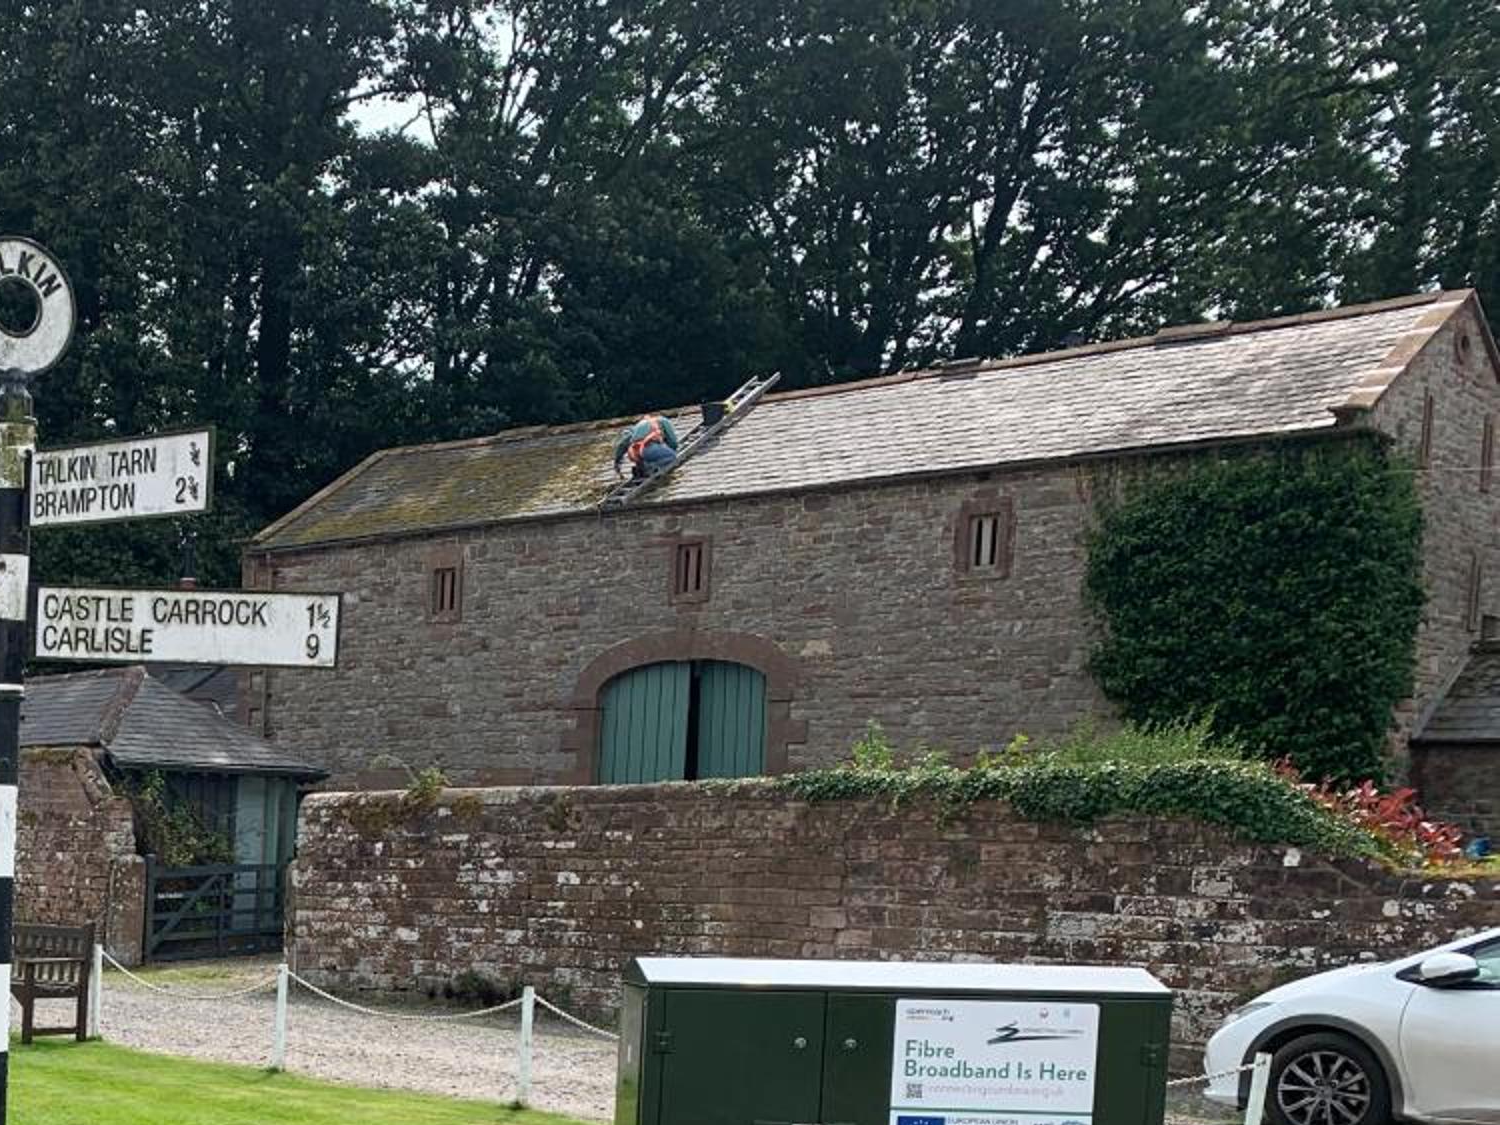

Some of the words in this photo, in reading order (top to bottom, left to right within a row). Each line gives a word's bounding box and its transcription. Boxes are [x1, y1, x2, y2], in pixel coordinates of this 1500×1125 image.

[36, 454, 97, 485] TALKIN
[108, 447, 157, 478] TARN
[34, 482, 135, 519] BRAMPTON
[43, 593, 133, 623] CASTLE
[152, 599, 268, 628] CARROCK
[42, 625, 153, 654] CARLISLE
[305, 633, 320, 659] 9
[905, 1039, 955, 1059] Fibre
[904, 1059, 1010, 1080] Broadband
[1017, 1062, 1032, 1080] Is
[1039, 1064, 1088, 1082] Here
